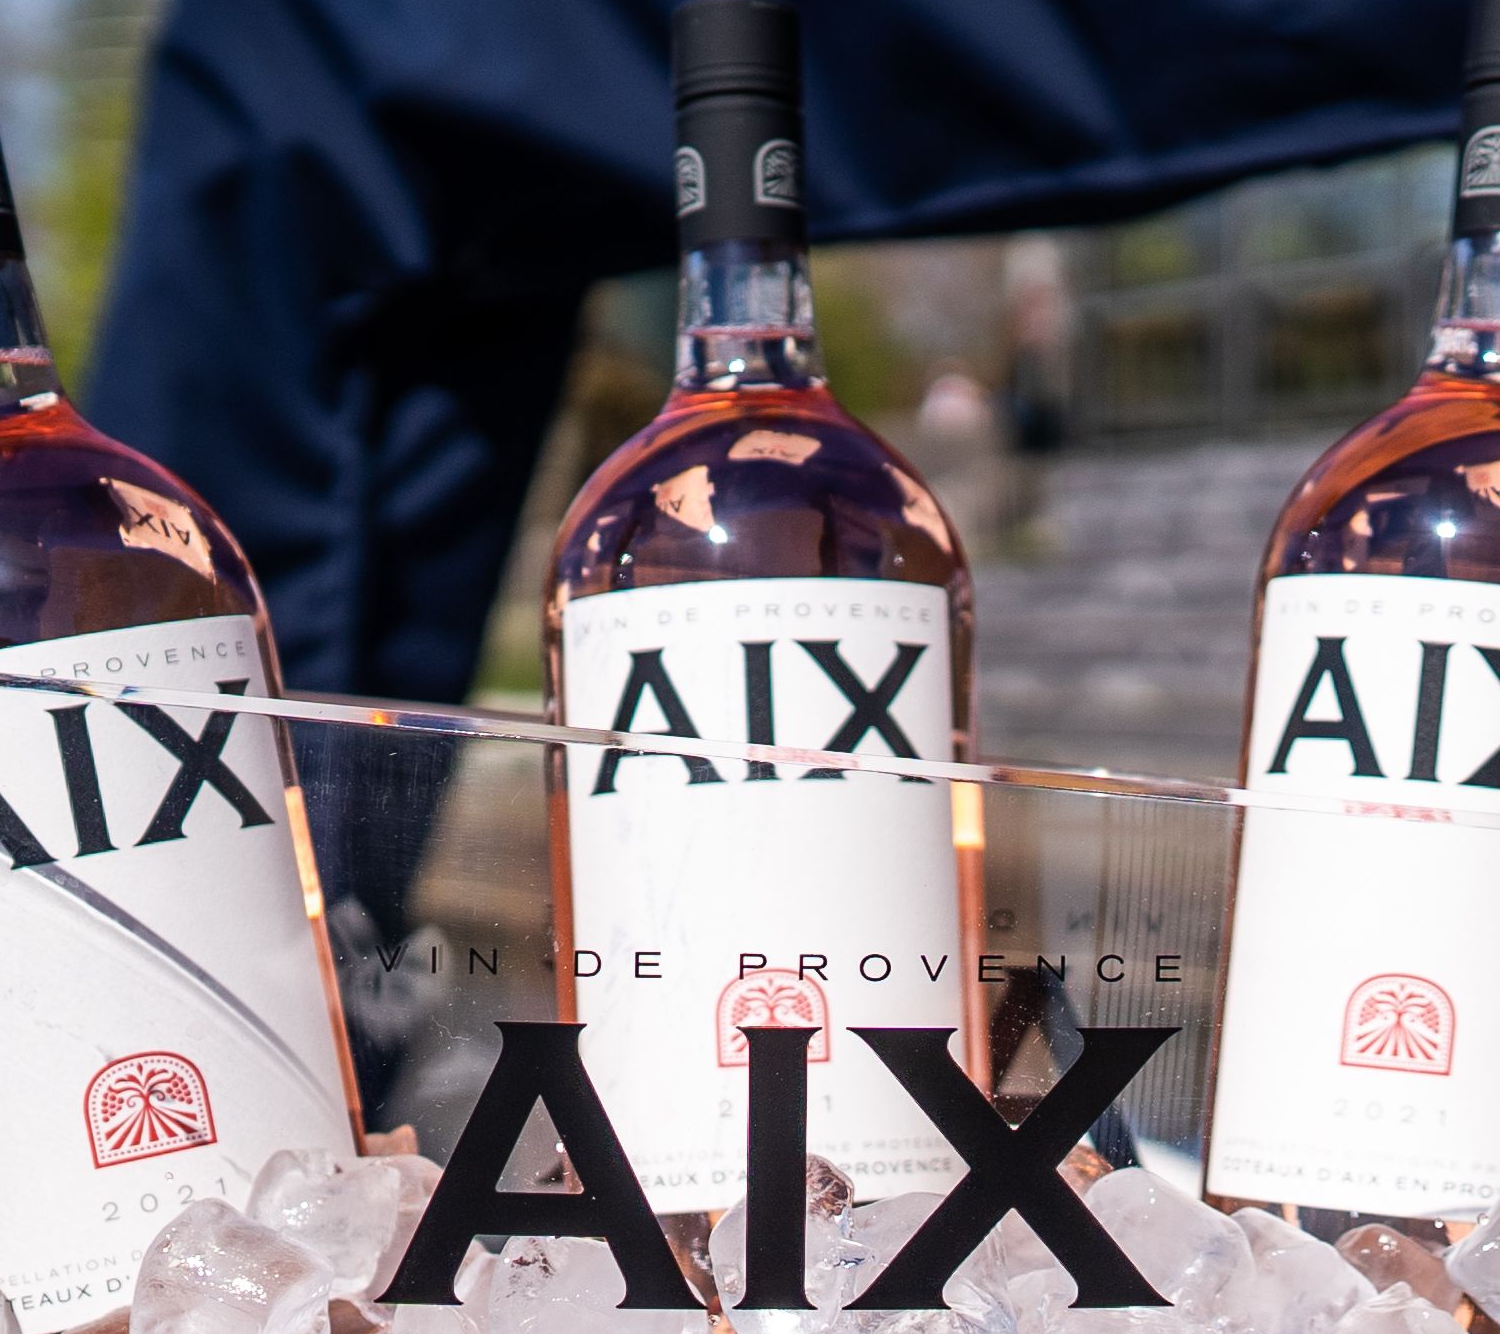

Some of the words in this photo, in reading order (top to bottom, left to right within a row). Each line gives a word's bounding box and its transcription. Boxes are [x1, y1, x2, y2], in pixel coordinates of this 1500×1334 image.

[658, 607, 697, 625] DE
[735, 602, 932, 623] PROVENCE
[590, 638, 934, 797] AIX
[375, 944, 498, 976] VIN
[573, 950, 663, 979] DE
[738, 952, 1184, 983] PROVENCE
[1332, 1098, 1449, 1126] 2021
[373, 1021, 1184, 1311] AIX
[640, 1171, 698, 1188] EAUX
[102, 1176, 227, 1223] 2021
[5, 1283, 92, 1313] TEAUX
